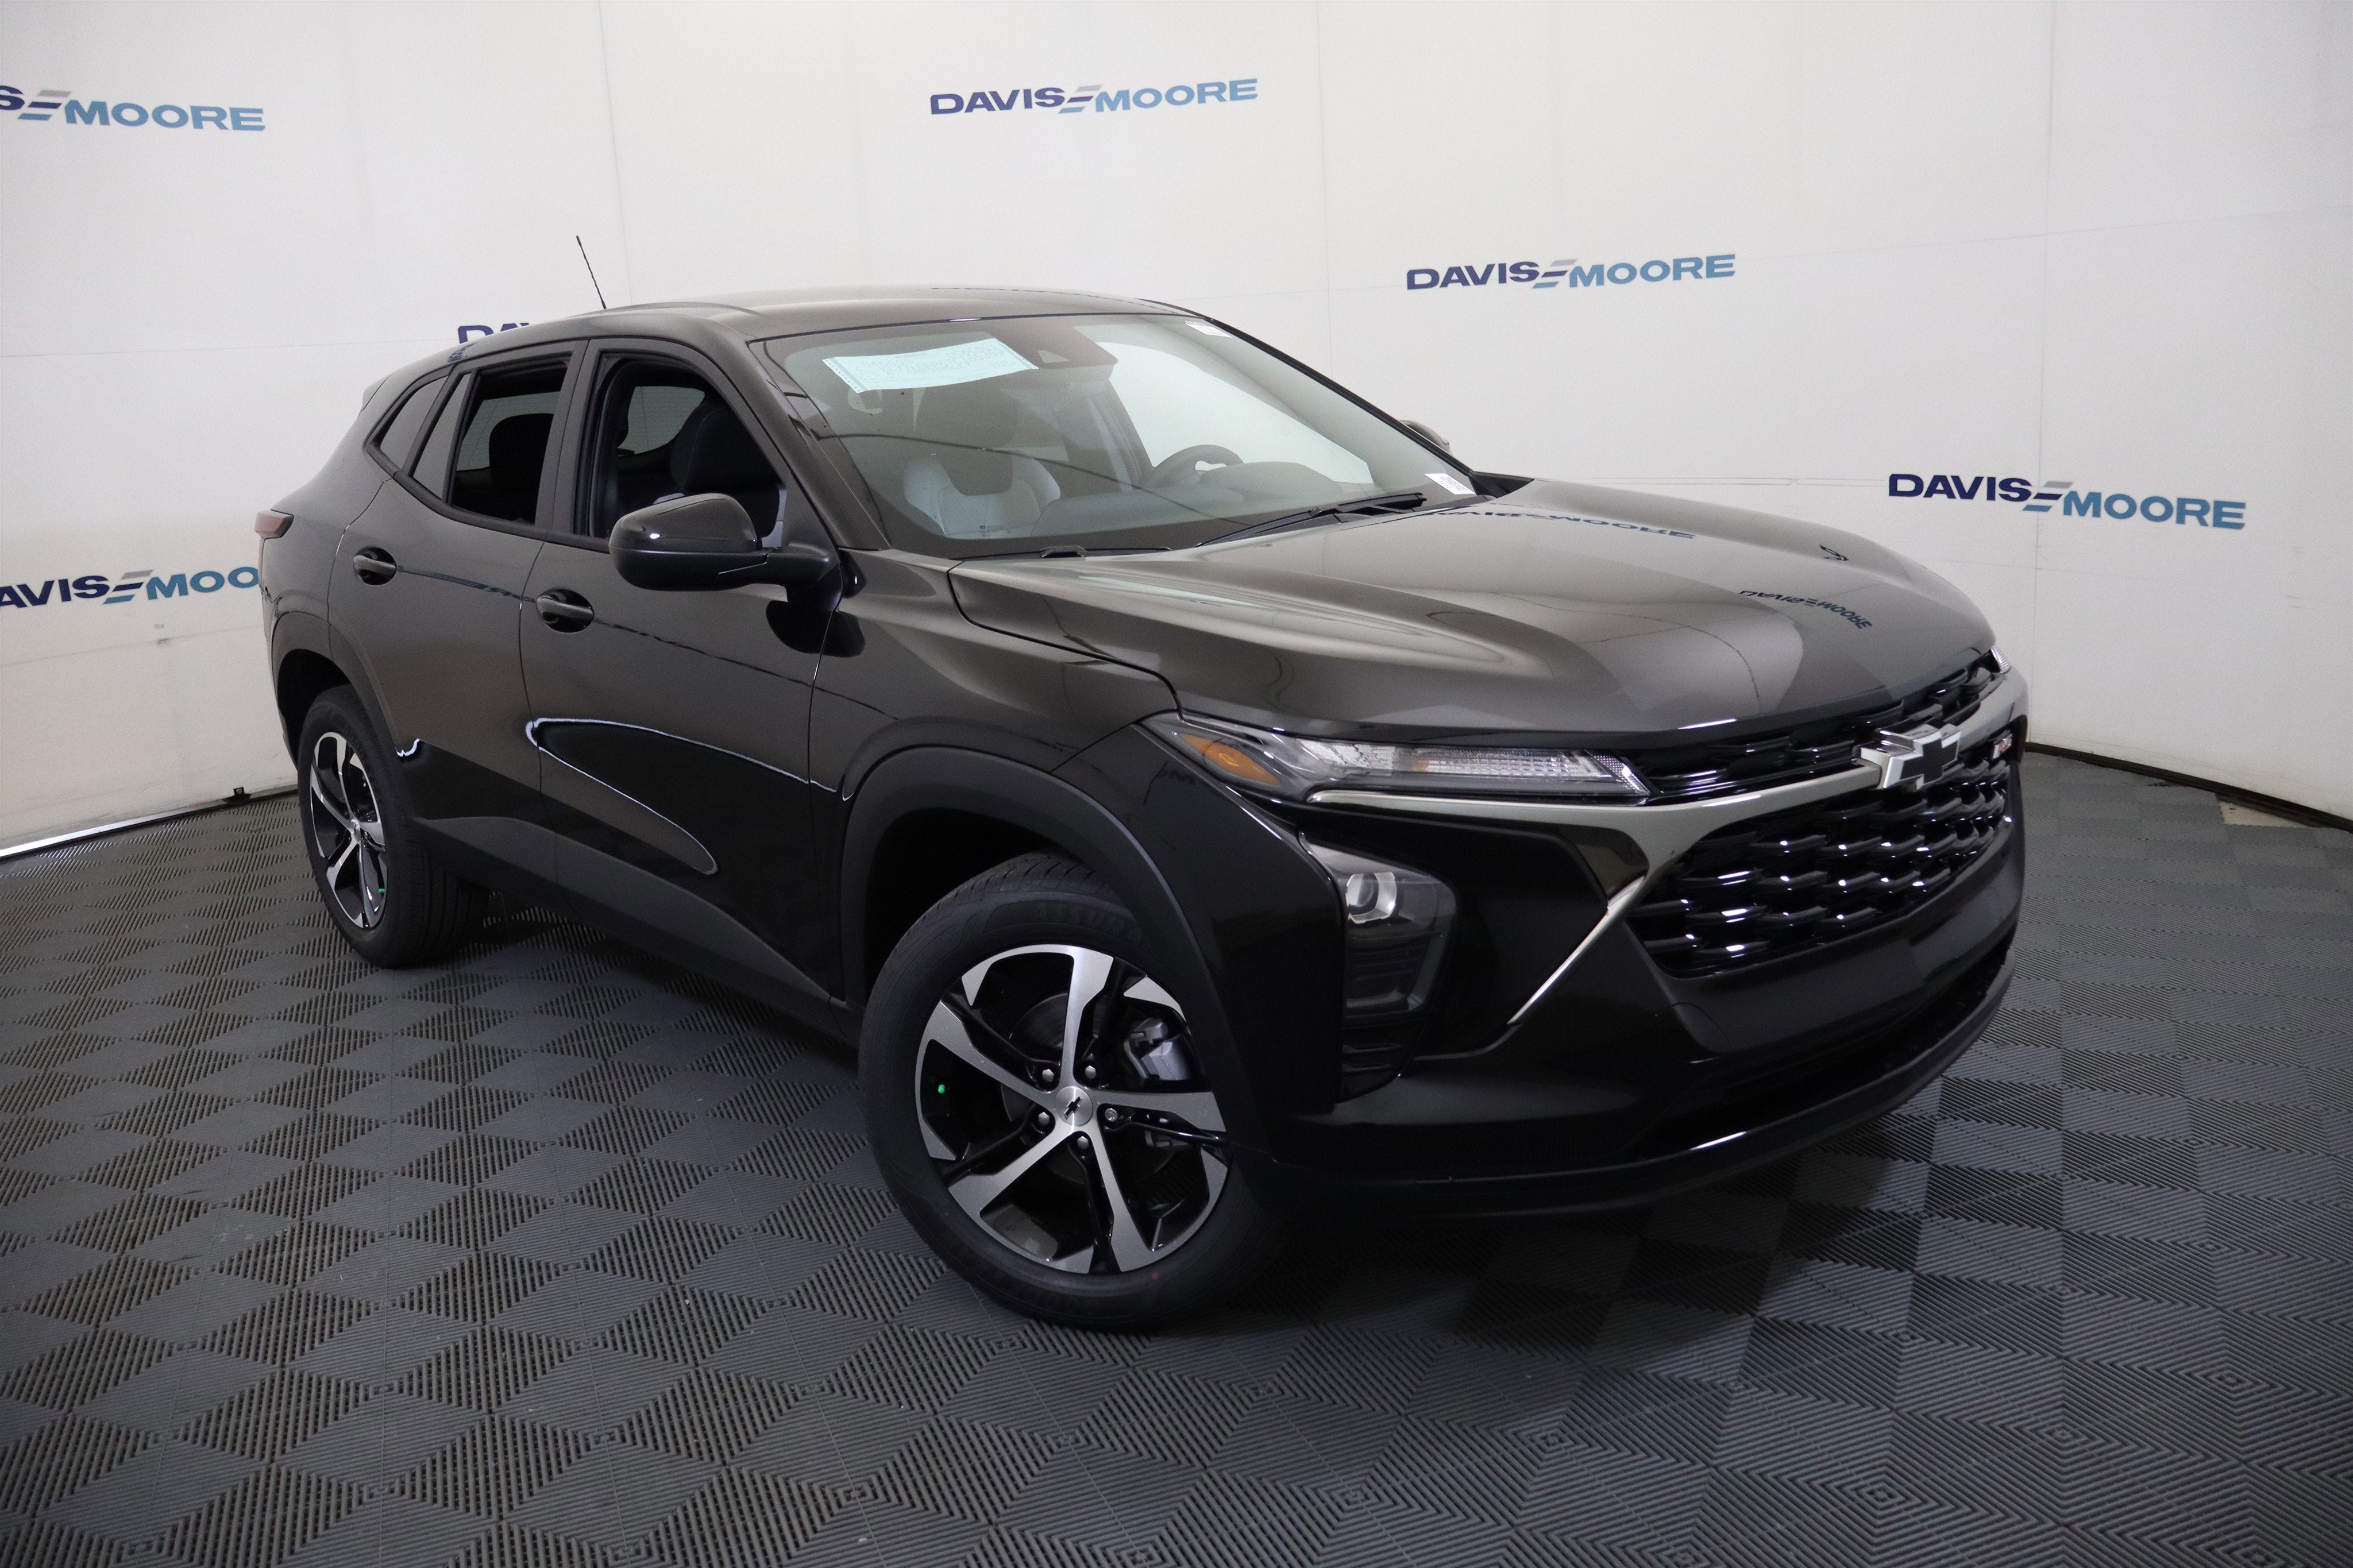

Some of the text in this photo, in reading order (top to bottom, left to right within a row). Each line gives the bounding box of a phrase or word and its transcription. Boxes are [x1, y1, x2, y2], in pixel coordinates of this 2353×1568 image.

[64, 99, 266, 132] MOORE
[929, 78, 1259, 115] DAVIS MOORE
[1406, 253, 1736, 291] DAVIS MOORE
[1888, 473, 2247, 531] DAVIS MOORE
[0, 566, 259, 609] AVIS MOO
